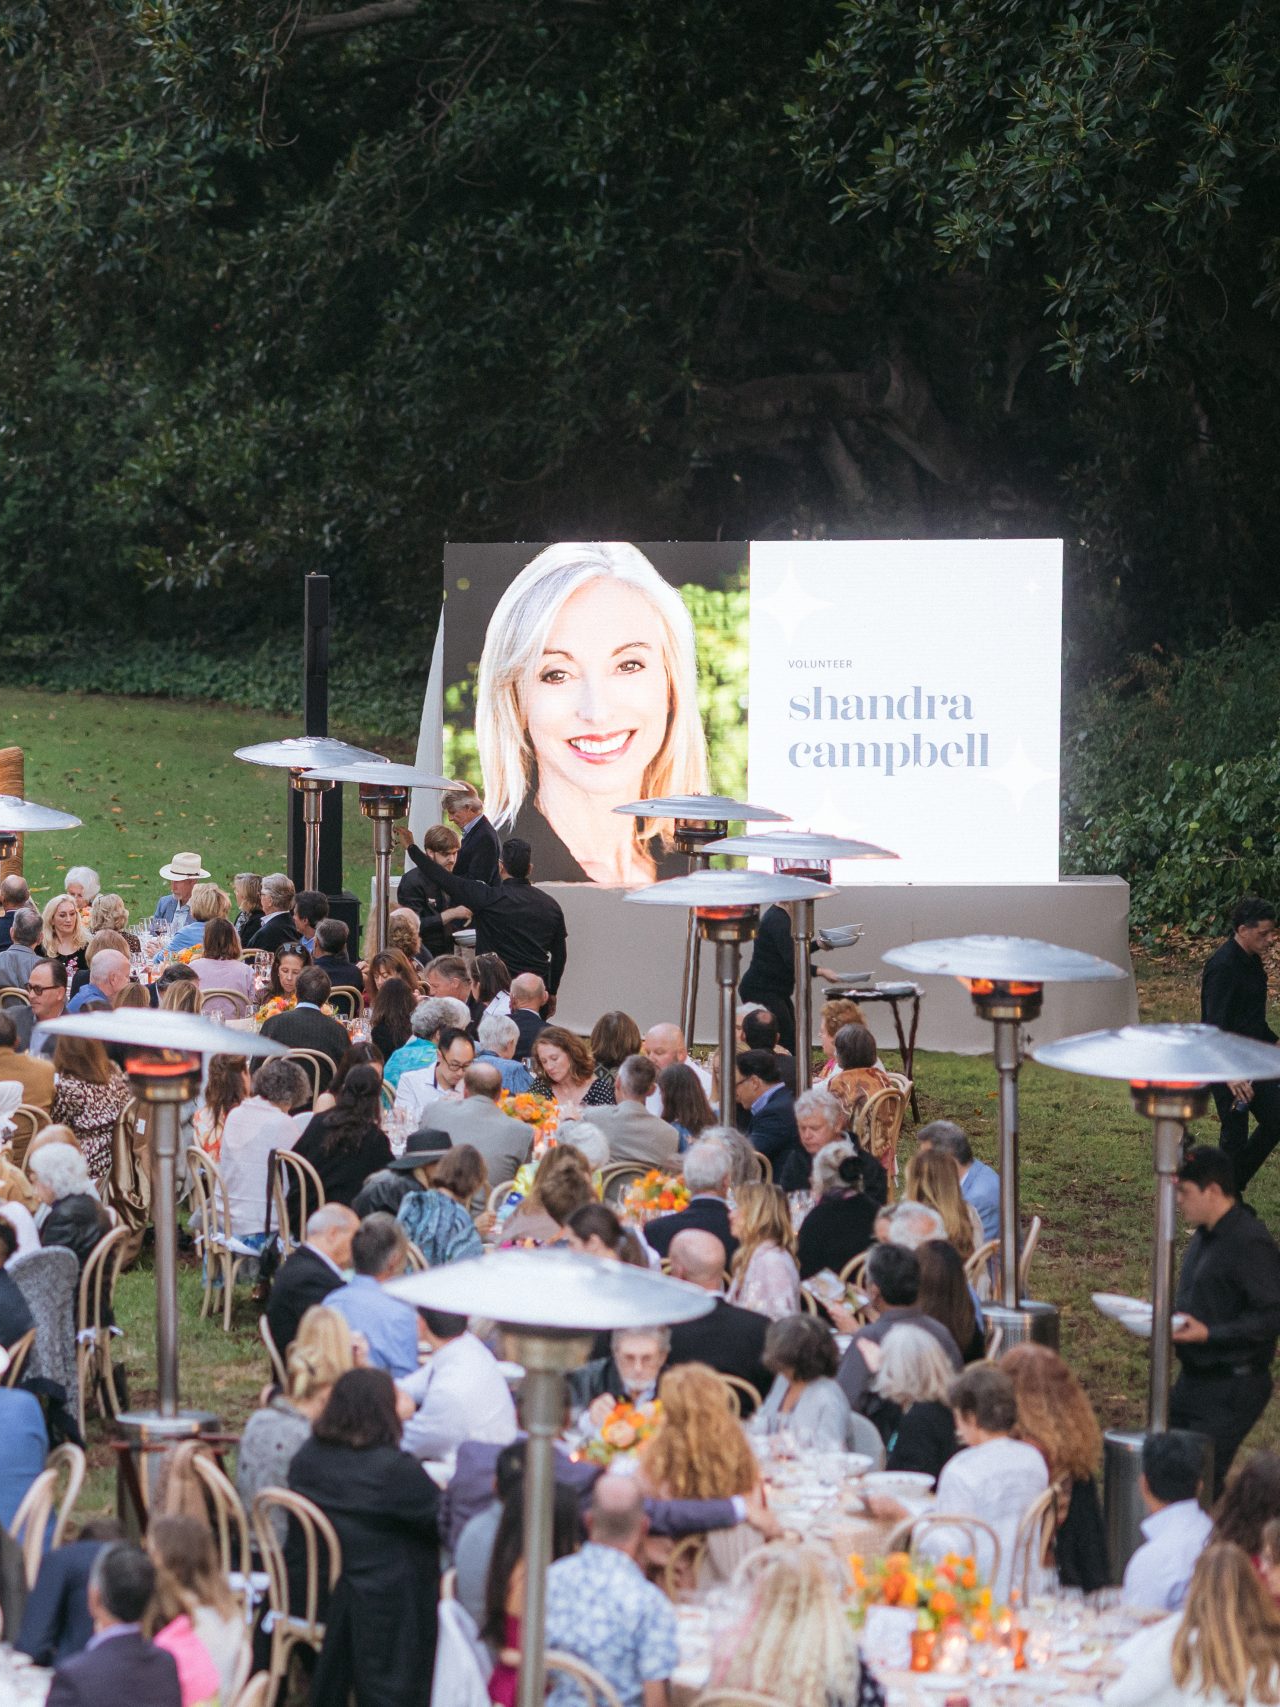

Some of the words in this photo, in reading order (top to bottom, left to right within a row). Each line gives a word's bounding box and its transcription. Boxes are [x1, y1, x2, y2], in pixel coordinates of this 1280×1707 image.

[788, 659, 853, 669] VOLUNTEER
[789, 686, 974, 720] shandra
[788, 733, 989, 776] campbell
